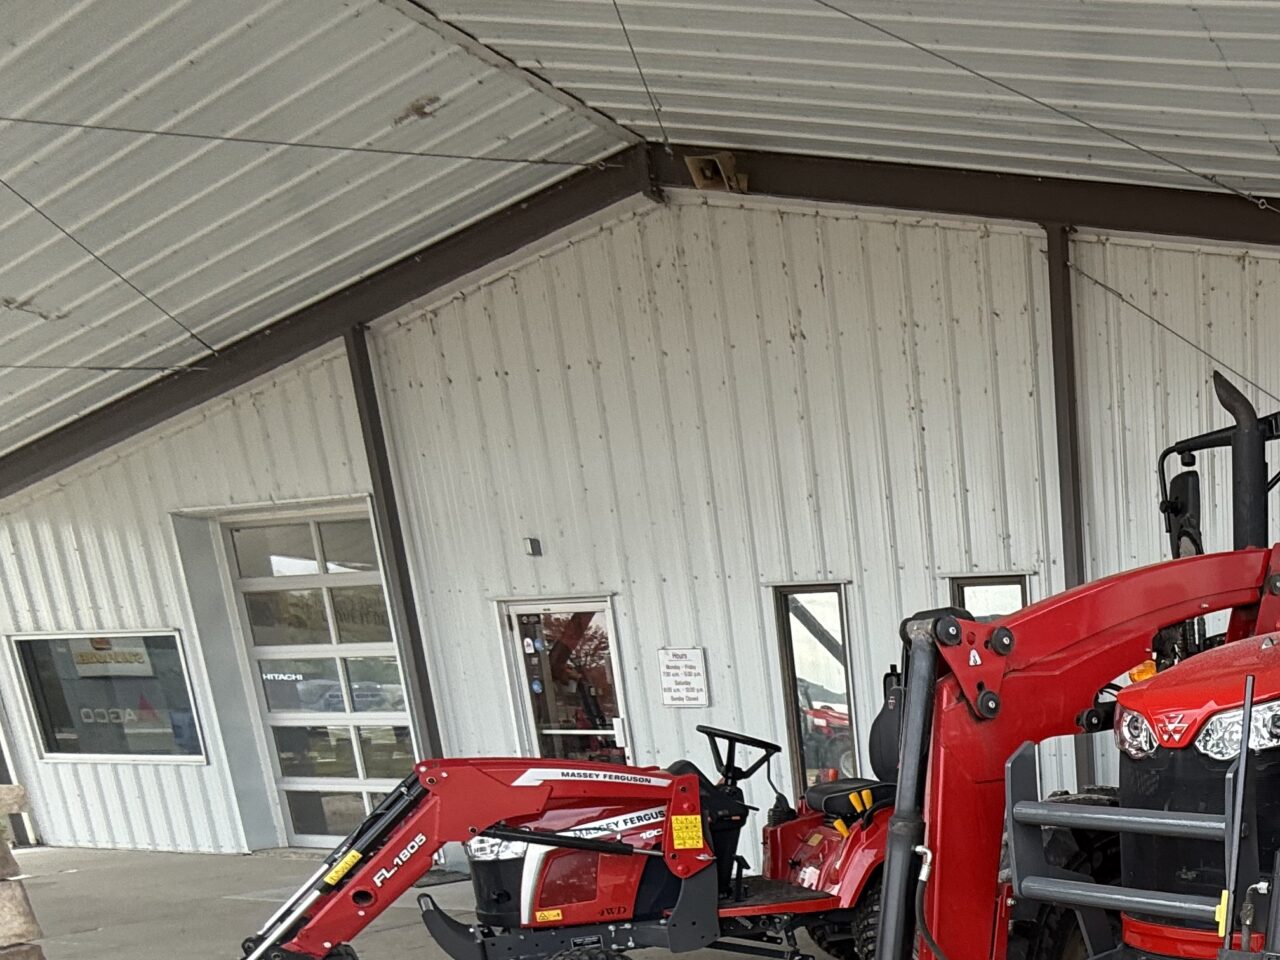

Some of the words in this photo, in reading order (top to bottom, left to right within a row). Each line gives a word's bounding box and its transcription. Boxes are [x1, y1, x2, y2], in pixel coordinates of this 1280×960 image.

[262, 673, 303, 681] HITACHI
[561, 771, 600, 779] MASSEY
[603, 773, 652, 784] FERGUSON
[573, 821, 620, 838] MASSEY
[622, 810, 666, 827] FERGUS
[372, 832, 427, 887] FL.1805
